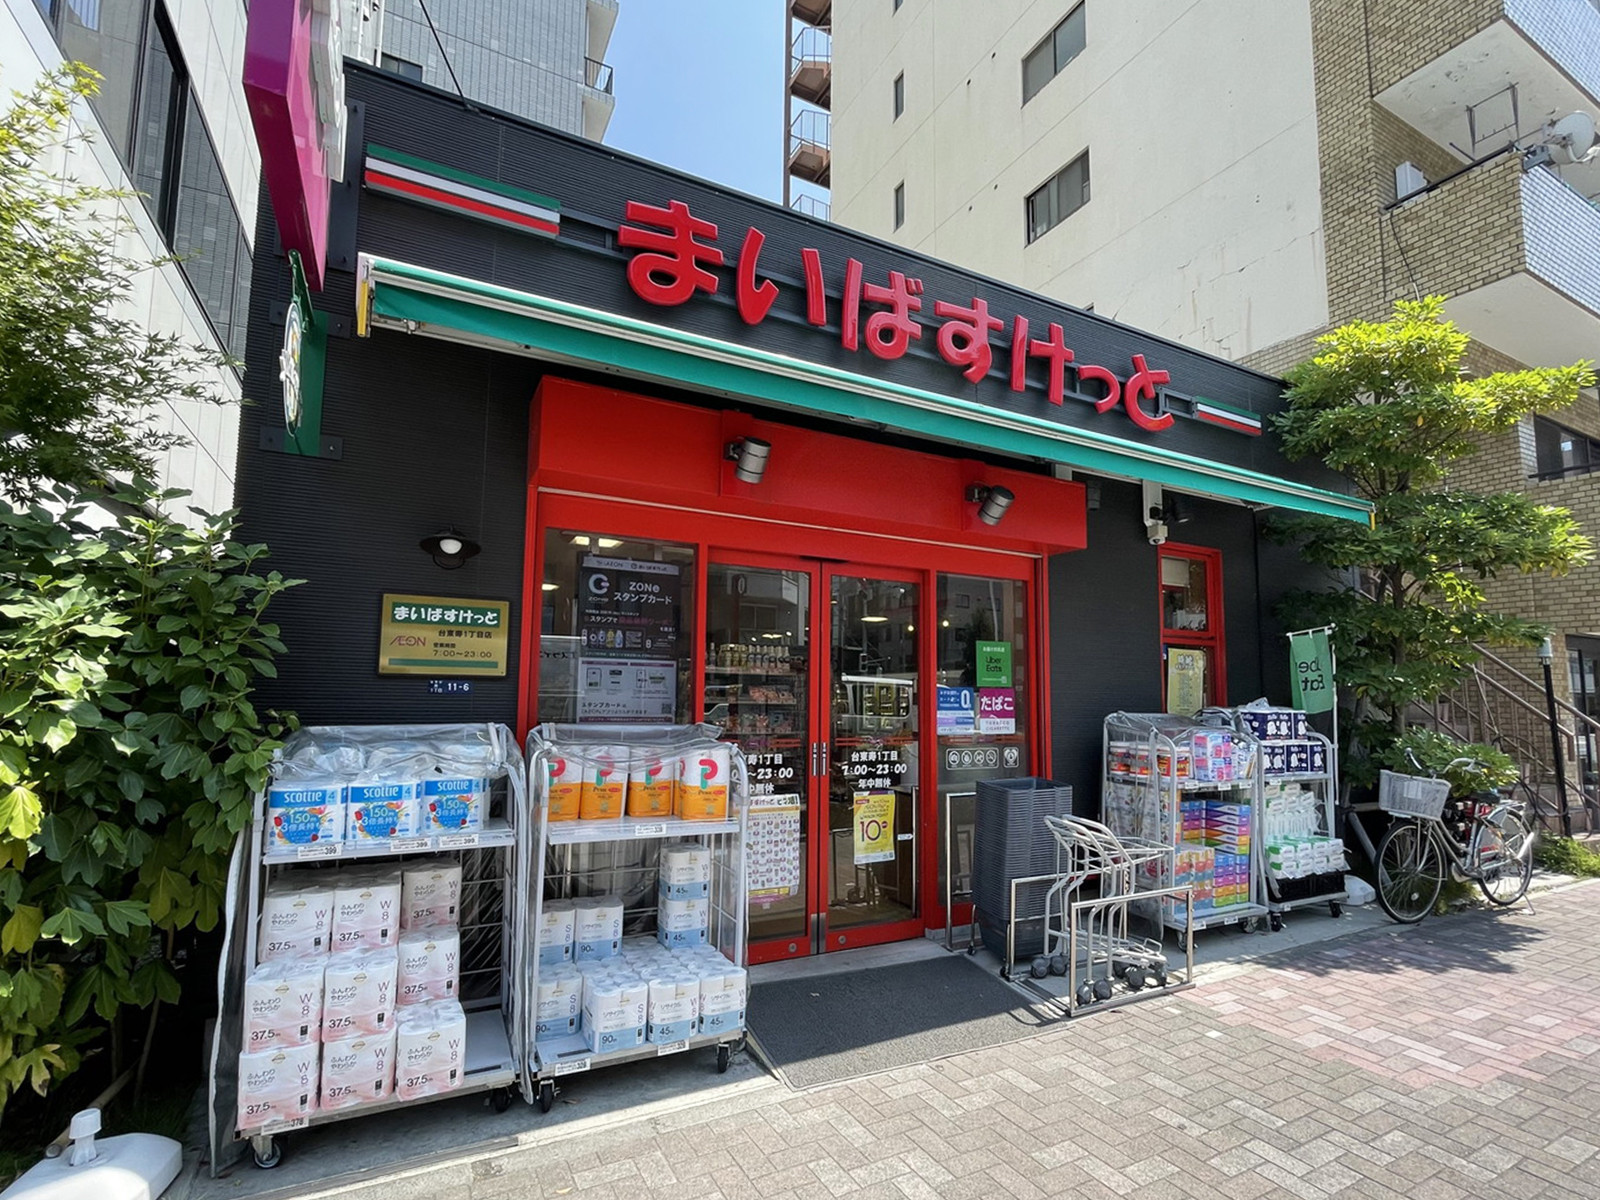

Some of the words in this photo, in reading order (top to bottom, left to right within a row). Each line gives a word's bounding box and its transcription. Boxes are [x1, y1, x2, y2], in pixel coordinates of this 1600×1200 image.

[618, 200, 1175, 432] まいばすけっと
[614, 592, 672, 605] スタンプカード
[394, 606, 498, 624] まいばすけっと
[448, 683, 469, 691] 11-6
[981, 696, 1014, 711] たばこ
[437, 781, 469, 791] scottie
[858, 777, 891, 789] 年中無休
[284, 791, 322, 803] scottie
[363, 787, 399, 798] scottie
[860, 820, 881, 841] 10
[450, 890, 456, 899] 8
[380, 900, 391, 909] W
[315, 909, 327, 919] W
[382, 911, 389, 920] 8
[315, 921, 323, 929] 8
[446, 952, 456, 961] W
[447, 963, 453, 972] 8
[378, 980, 390, 991] W
[300, 993, 313, 1003] W
[379, 993, 386, 1003] 8
[302, 1005, 309, 1015] 8
[449, 1038, 460, 1049] W
[375, 1047, 387, 1058] W
[450, 1050, 457, 1060] 8
[297, 1061, 310, 1073] W
[376, 1060, 384, 1070] 8
[301, 1074, 308, 1084] 8
